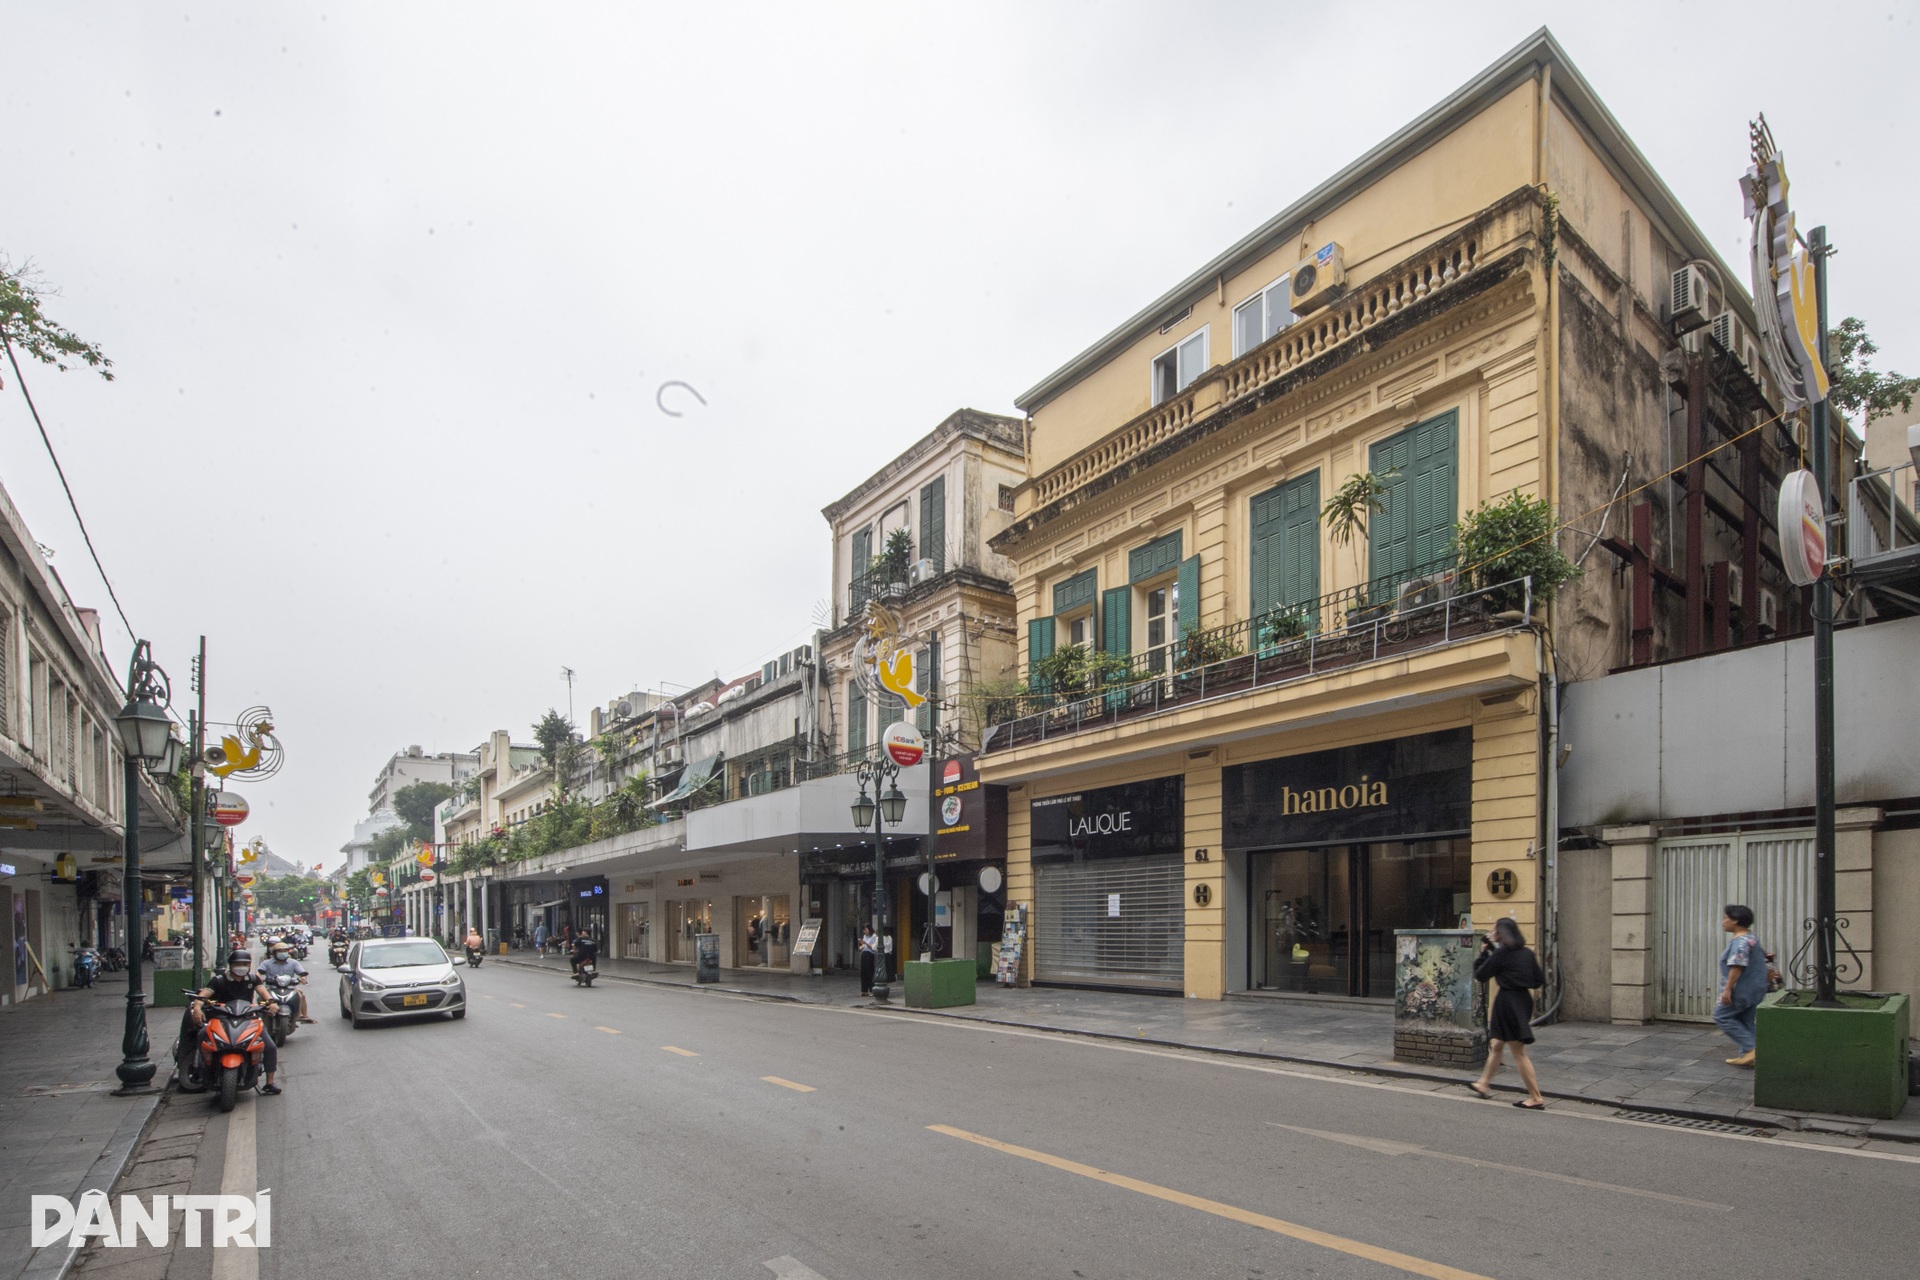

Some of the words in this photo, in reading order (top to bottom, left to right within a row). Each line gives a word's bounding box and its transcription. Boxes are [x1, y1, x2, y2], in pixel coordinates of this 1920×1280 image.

[893, 735, 916, 745] HDBank
[1281, 775, 1389, 815] hanoia
[1070, 811, 1132, 837] LALIQUE
[1195, 848, 1209, 863] 61
[861, 861, 877, 872] BAN
